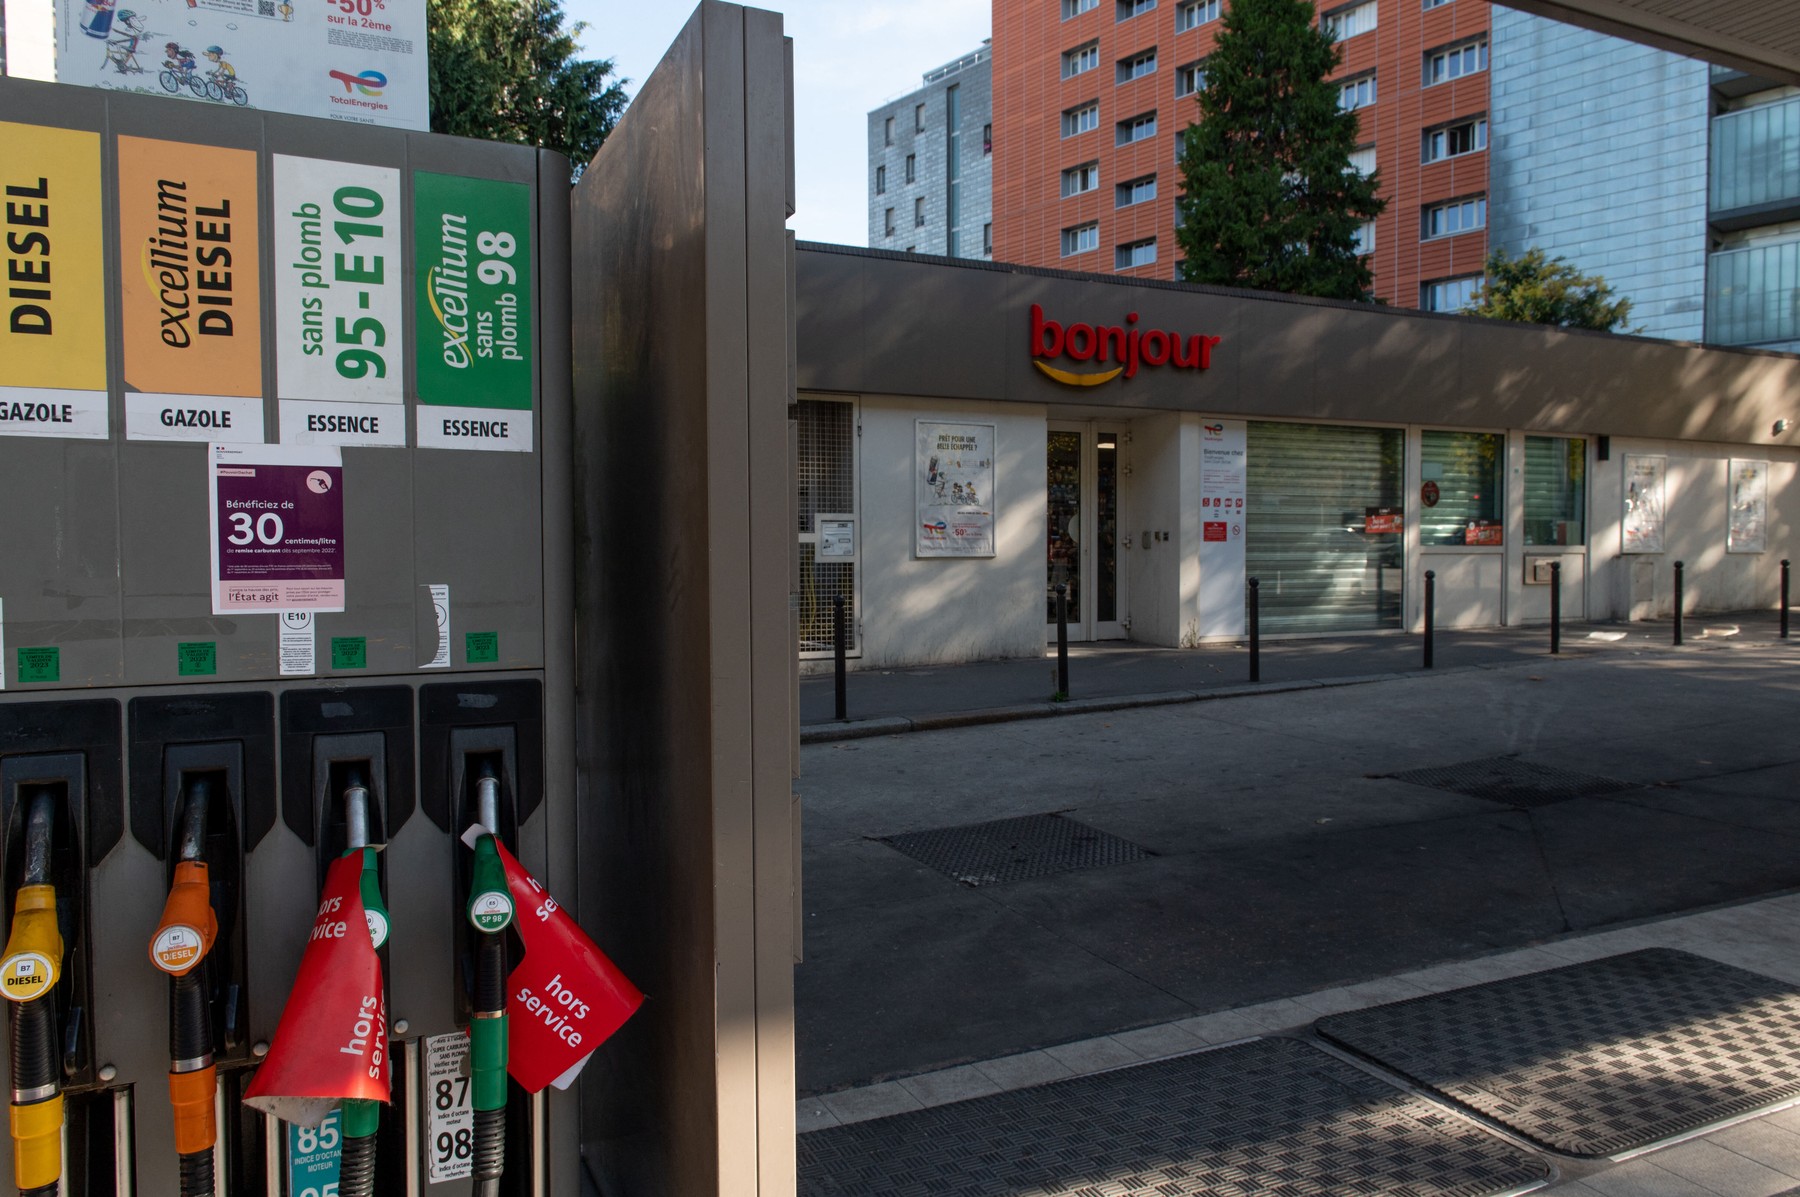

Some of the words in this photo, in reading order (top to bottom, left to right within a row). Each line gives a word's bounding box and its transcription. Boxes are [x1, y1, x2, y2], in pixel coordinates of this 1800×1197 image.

[327, 15, 345, 25] sur
[348, 16, 358, 26] la
[361, 18, 392, 31] 2ème
[330, 96, 388, 110] TotalEnergies
[6, 177, 52, 335] DIESEL
[149, 179, 190, 348] excellium
[292, 202, 330, 289] plomb
[476, 231, 516, 285] 98
[195, 199, 233, 336] DIESEL
[333, 186, 386, 379] 95-E10
[434, 212, 469, 369] excellium
[302, 298, 323, 356] sans
[476, 311, 493, 358] sans
[495, 292, 523, 360] plomb
[1031, 304, 1222, 379] bonjour
[160, 408, 231, 428] GAZOLE
[307, 415, 379, 434] ESSENCE
[443, 419, 508, 438] ESSENCE
[226, 500, 278, 509] Bénéficiez
[281, 500, 294, 509] de
[227, 512, 284, 545] 30
[229, 592, 256, 601] l'État
[260, 593, 279, 602] agit
[317, 896, 342, 917] ors
[163, 950, 193, 961] DIESEL
[7, 976, 43, 986] DIESEL
[545, 974, 590, 1020] hors
[340, 996, 378, 1056] hors
[368, 989, 385, 1080] servic
[516, 987, 582, 1048] service
[436, 1077, 470, 1110] 87
[298, 1117, 339, 1153] 85
[437, 1128, 471, 1163] 98
[295, 1155, 314, 1165] INDICE
[316, 1150, 342, 1160] D'OCTAN
[308, 1161, 333, 1172] MOTEUR
